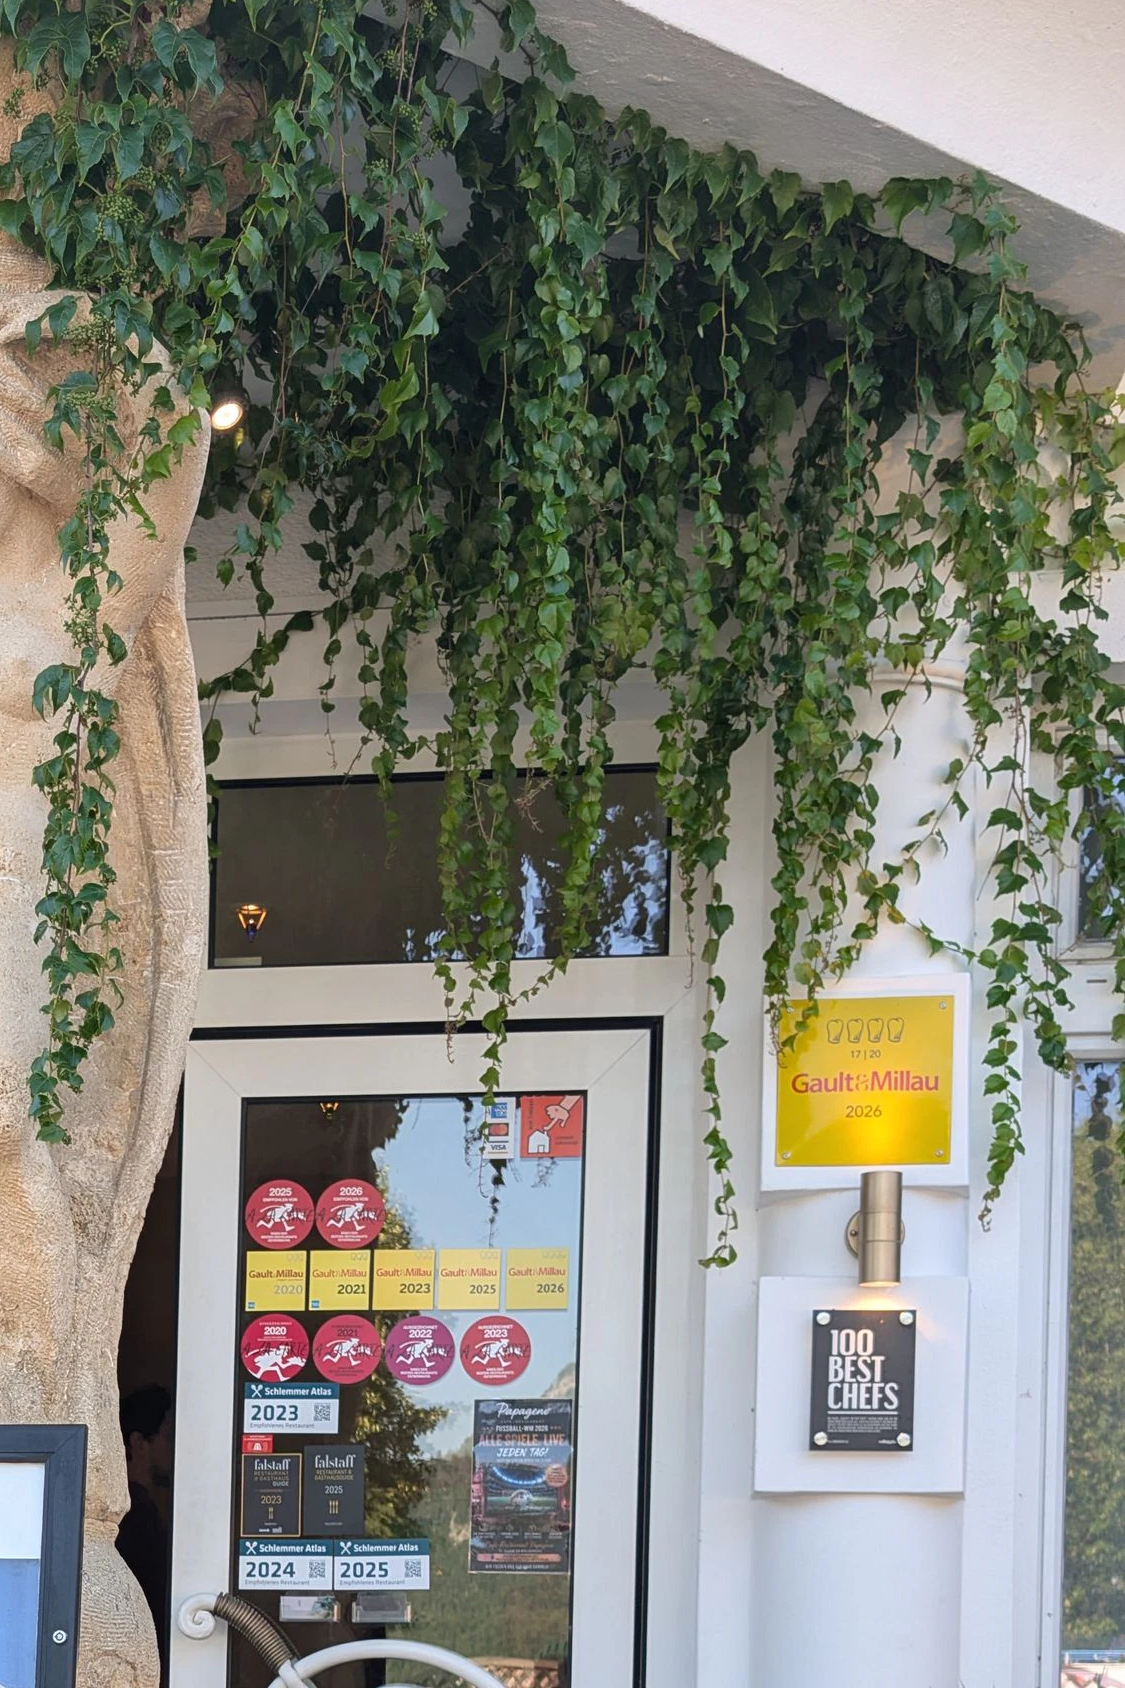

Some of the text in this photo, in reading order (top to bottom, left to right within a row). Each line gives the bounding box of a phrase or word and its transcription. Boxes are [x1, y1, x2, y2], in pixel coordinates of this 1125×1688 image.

[792, 1071, 939, 1094] Gault&Millau
[846, 1105, 882, 1118] 2026
[269, 1188, 292, 1196] 2025
[340, 1187, 363, 1195] 2026
[274, 1285, 303, 1295] 2020
[337, 1284, 366, 1294] 2021
[399, 1283, 431, 1294] 2023
[469, 1284, 496, 1294] 2025
[536, 1283, 564, 1293] 2026
[264, 1327, 287, 1335] 2020
[409, 1330, 432, 1338] 2022
[484, 1330, 508, 1338] 2023
[830, 1329, 874, 1356] 100
[828, 1356, 886, 1382] BEST
[264, 1387, 332, 1396] Schlemmer Atlas
[827, 1382, 899, 1410] CHEFS
[251, 1405, 298, 1421] 2023
[495, 1402, 552, 1420] Papageno
[478, 1434, 502, 1447] ALLE
[496, 1448, 549, 1457] JEDEN TAG!
[254, 1459, 291, 1471] falstaff
[315, 1454, 356, 1469] falstaff
[324, 1486, 344, 1494] 2025
[260, 1495, 282, 1505] 2023
[259, 1544, 327, 1553] Schlemmer Atlas
[353, 1543, 419, 1552] Schlemmer Atlas
[245, 1562, 296, 1578] 2024
[340, 1562, 389, 1578] 2025
